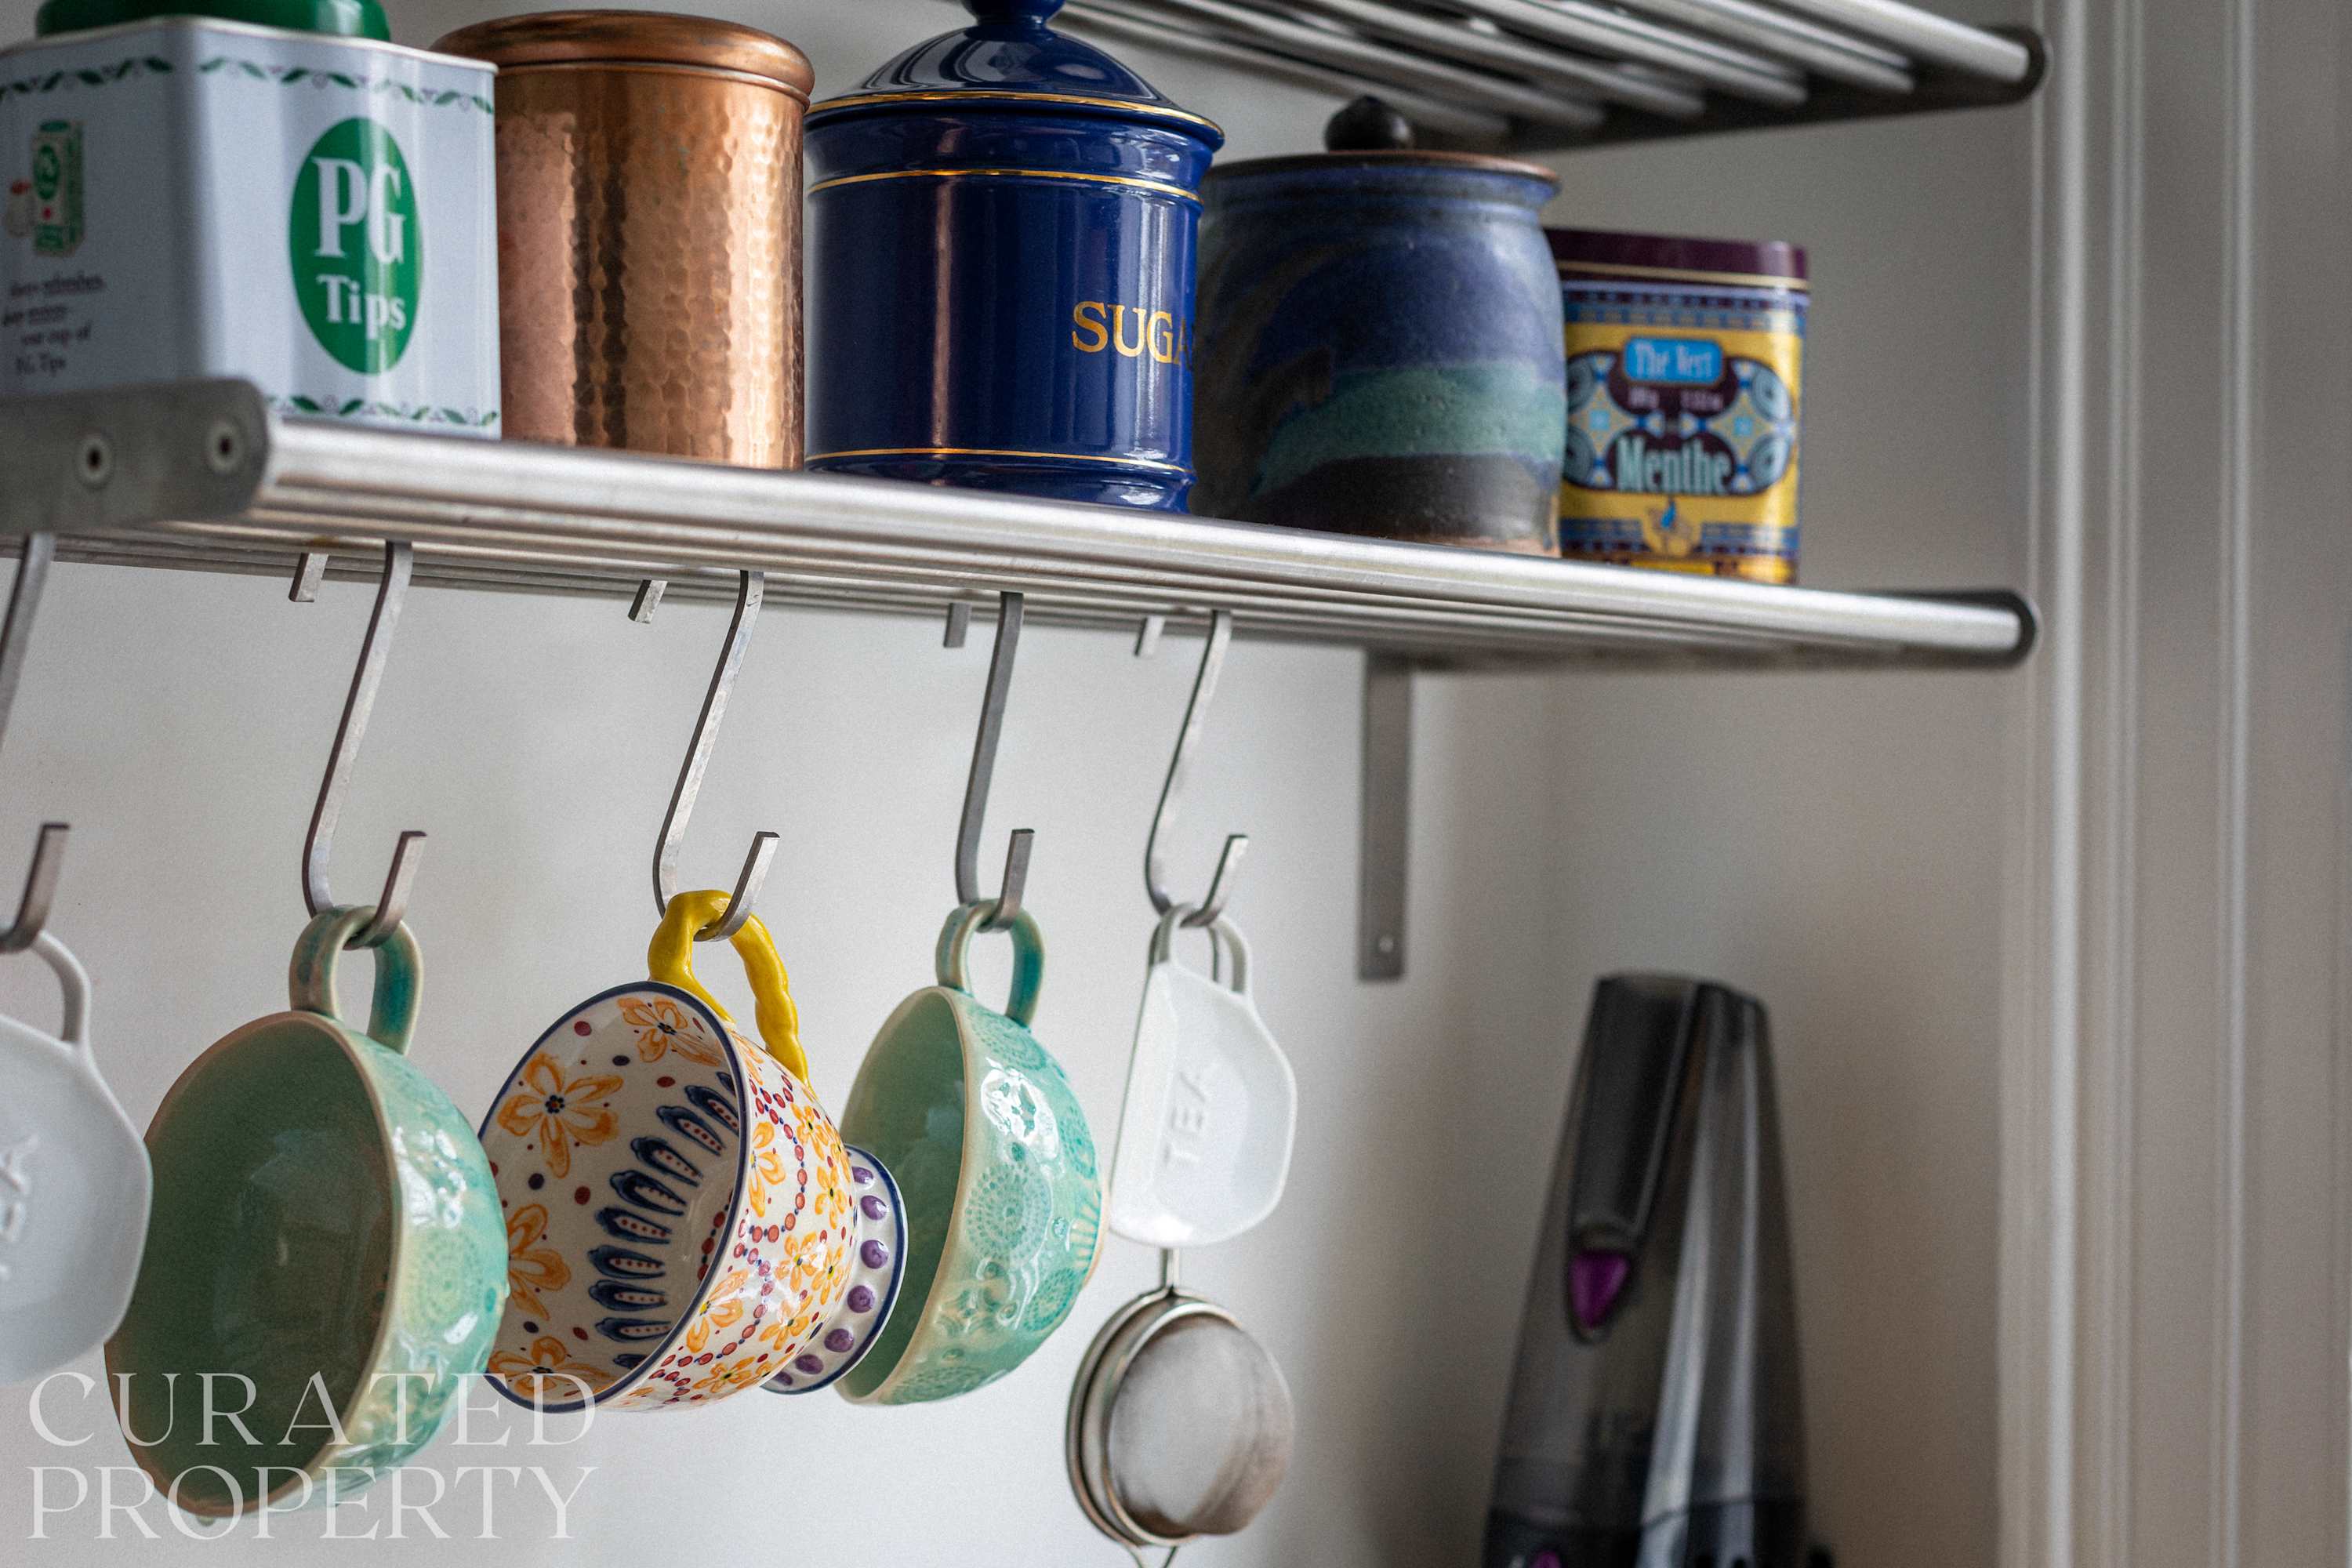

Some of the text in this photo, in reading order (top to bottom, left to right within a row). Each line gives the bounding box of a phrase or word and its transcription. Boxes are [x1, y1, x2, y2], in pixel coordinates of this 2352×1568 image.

[310, 156, 406, 264] PG
[316, 274, 407, 340] Tips
[1617, 435, 1731, 495] Menthe
